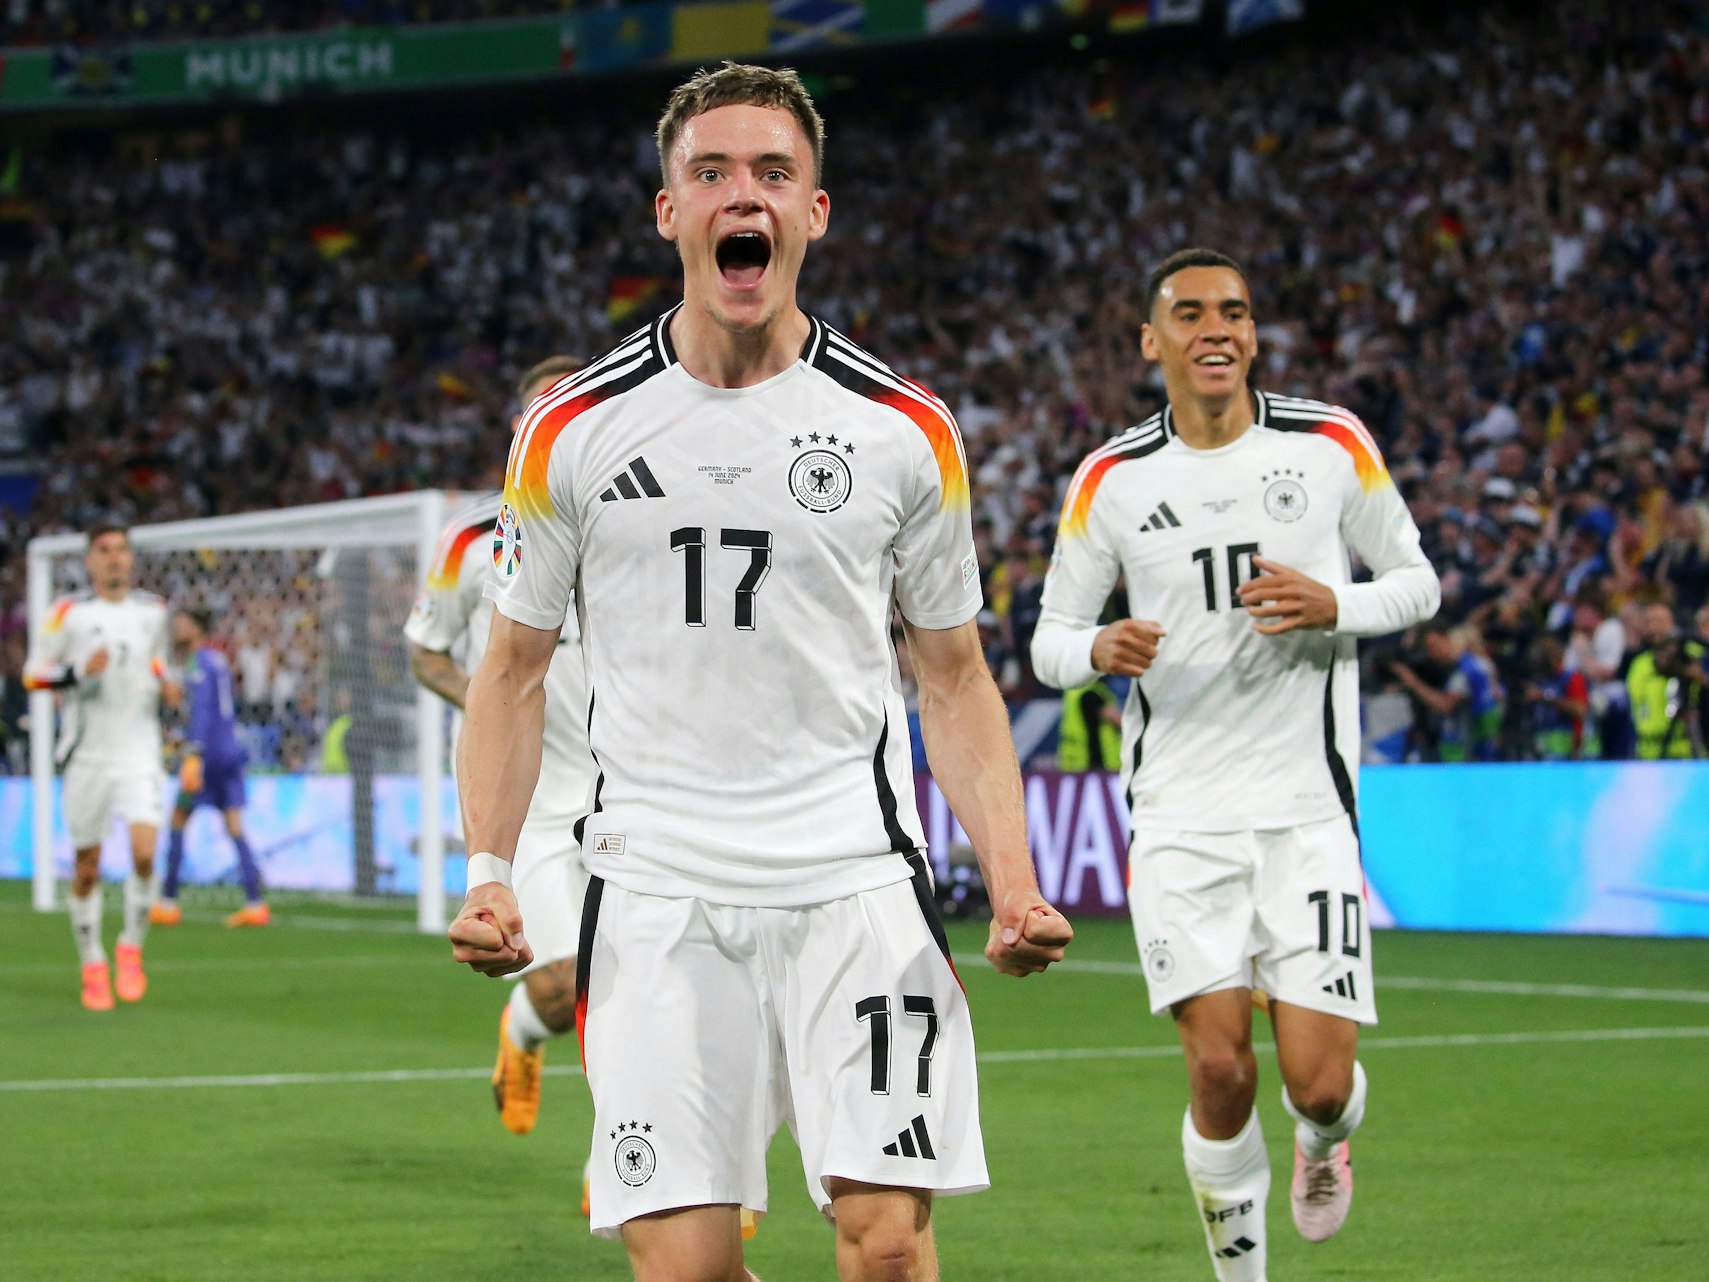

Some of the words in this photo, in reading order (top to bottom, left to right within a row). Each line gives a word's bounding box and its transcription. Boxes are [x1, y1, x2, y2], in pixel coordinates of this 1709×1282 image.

[185, 43, 392, 85] MUNICH
[803, 457, 840, 471] DEUTSCHER
[670, 527, 773, 631] 17
[1192, 542, 1262, 613] 10
[1308, 890, 1361, 960] 10
[855, 994, 940, 1098] 17
